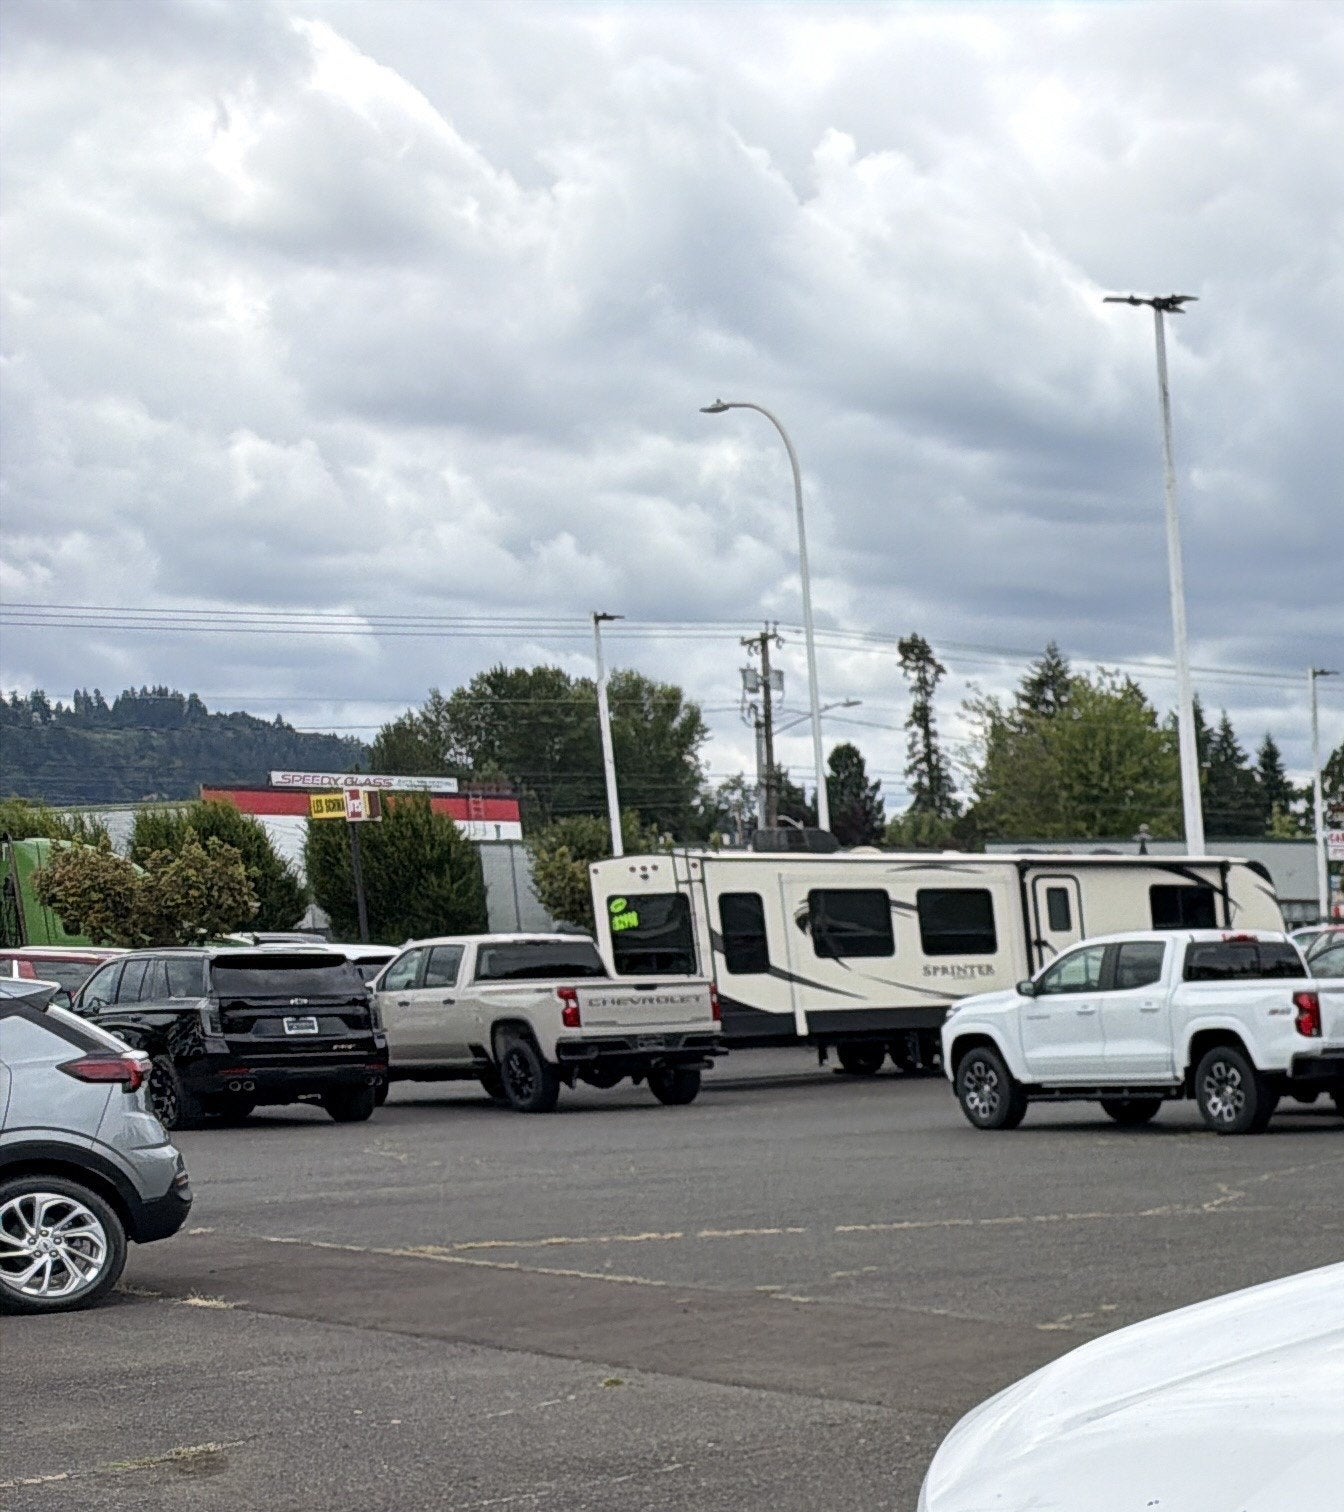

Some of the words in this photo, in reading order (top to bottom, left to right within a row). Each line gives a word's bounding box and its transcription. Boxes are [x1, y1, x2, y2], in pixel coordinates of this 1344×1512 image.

[278, 773, 341, 786] SPEEDY
[343, 776, 394, 788] GLASS
[587, 995, 700, 1007] CHEVROLET
